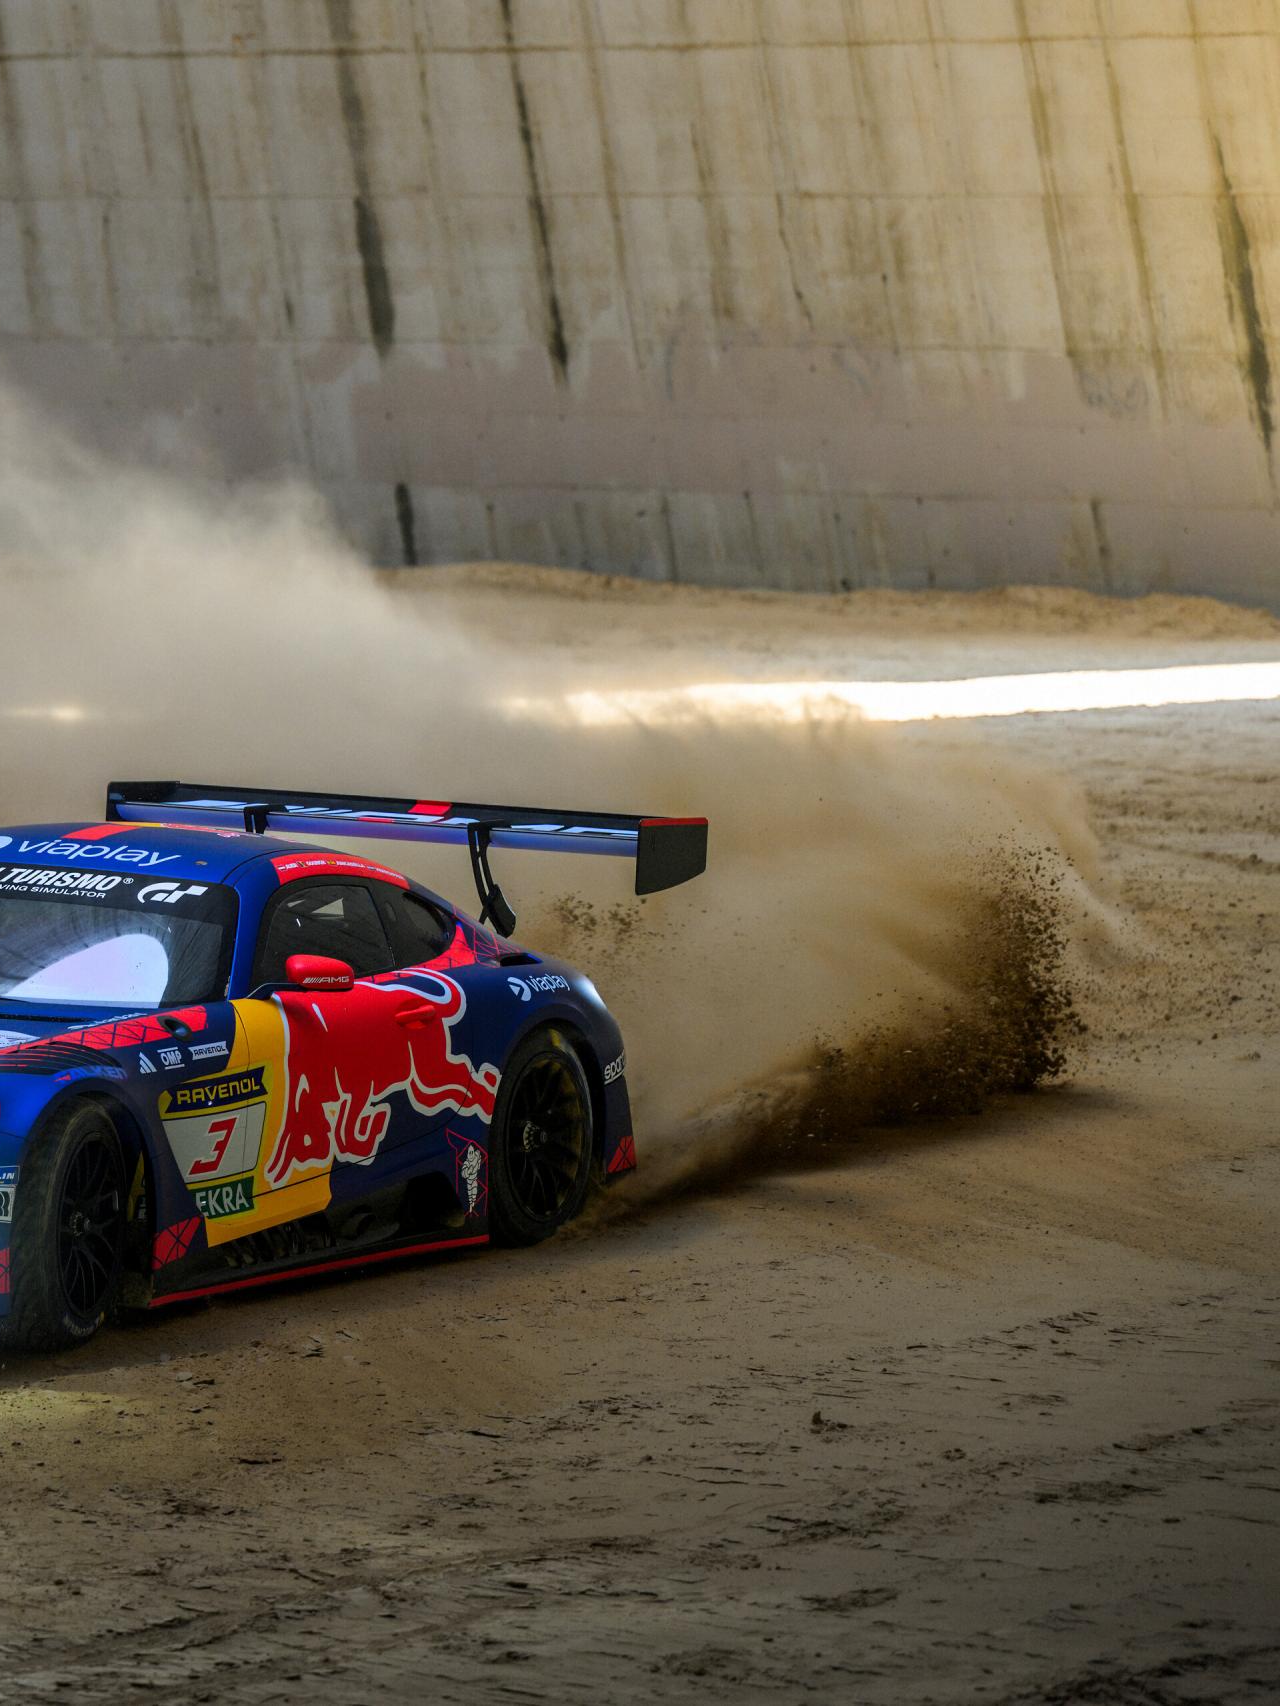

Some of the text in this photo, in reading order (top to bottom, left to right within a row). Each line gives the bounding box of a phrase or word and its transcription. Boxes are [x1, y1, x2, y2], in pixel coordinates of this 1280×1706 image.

[18, 839, 182, 867] viaplay
[30, 886, 106, 899] SIMULATOR
[319, 976, 350, 984] AMG
[525, 973, 570, 993] viaplay
[160, 1050, 182, 1066] OMP
[193, 1045, 226, 1058] RAVENOL
[176, 1076, 261, 1105] RAVENOL
[188, 1116, 238, 1176] 3
